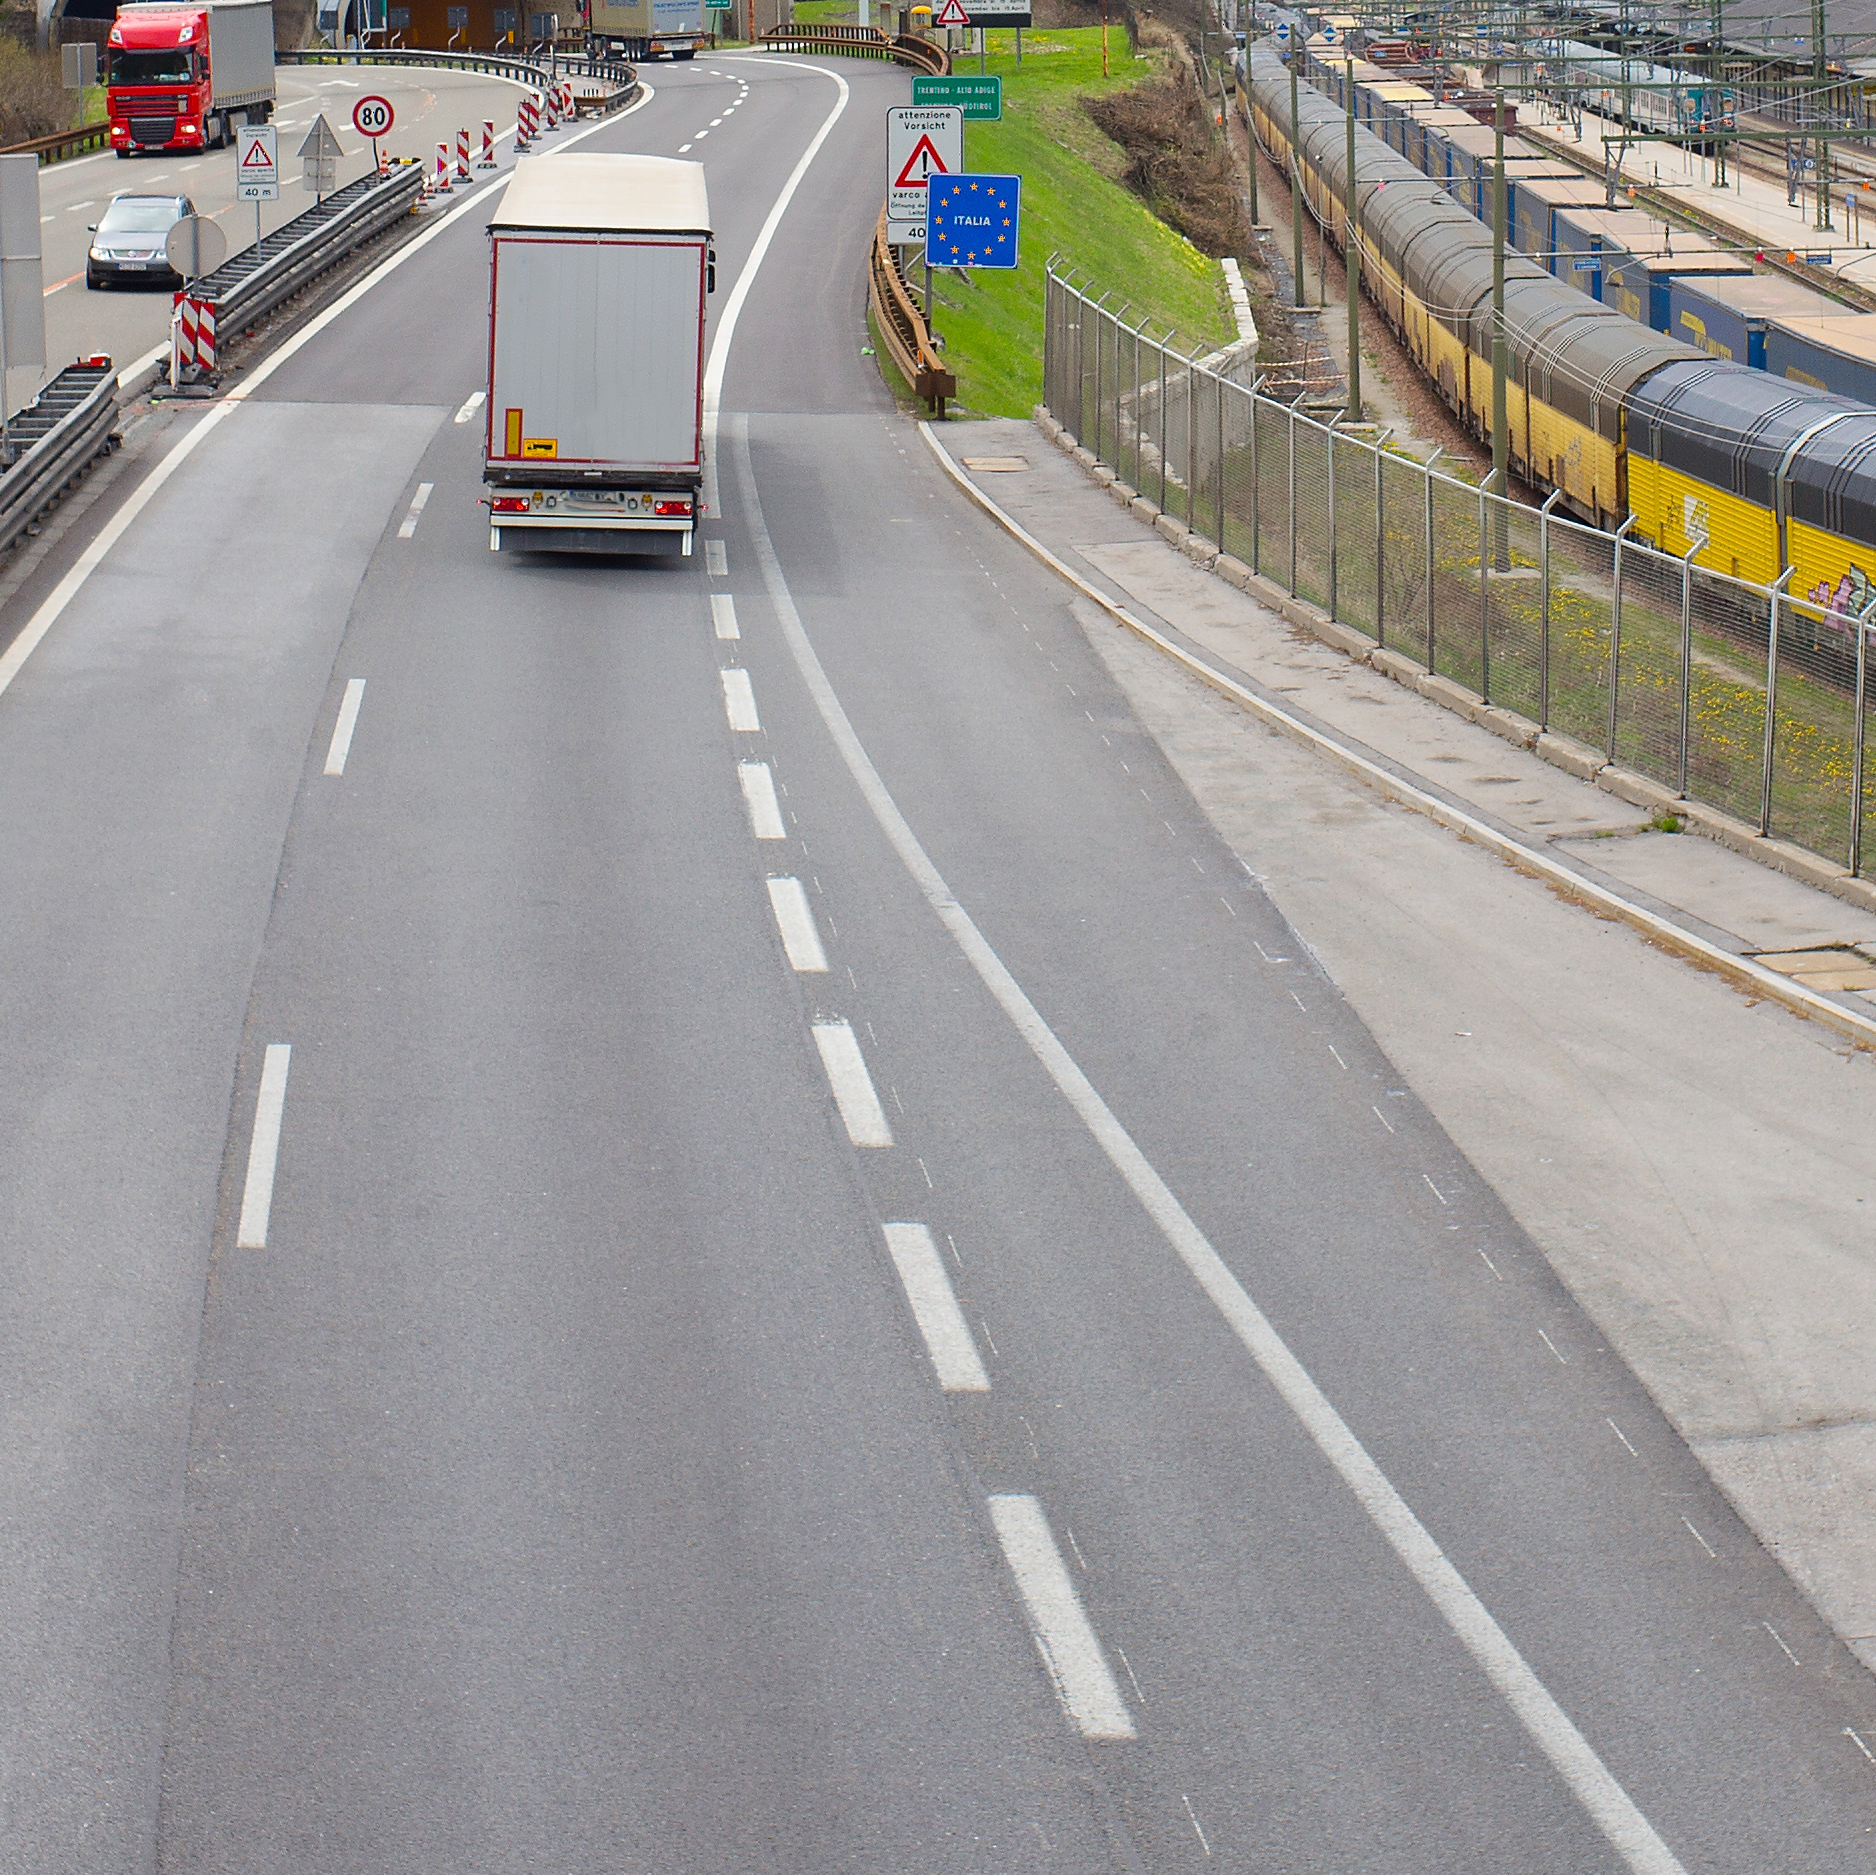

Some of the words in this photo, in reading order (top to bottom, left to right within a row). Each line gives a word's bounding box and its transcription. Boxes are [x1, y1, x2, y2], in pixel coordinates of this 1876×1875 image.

[917, 86, 950, 94] TRENTINO
[957, 86, 972, 94] ALTO
[974, 86, 996, 94] ADIGE
[362, 107, 385, 125] 80
[898, 111, 951, 119] attenzione
[904, 122, 946, 130] Vorsicht
[245, 188, 259, 196] 40
[954, 215, 991, 226] ITALIA
